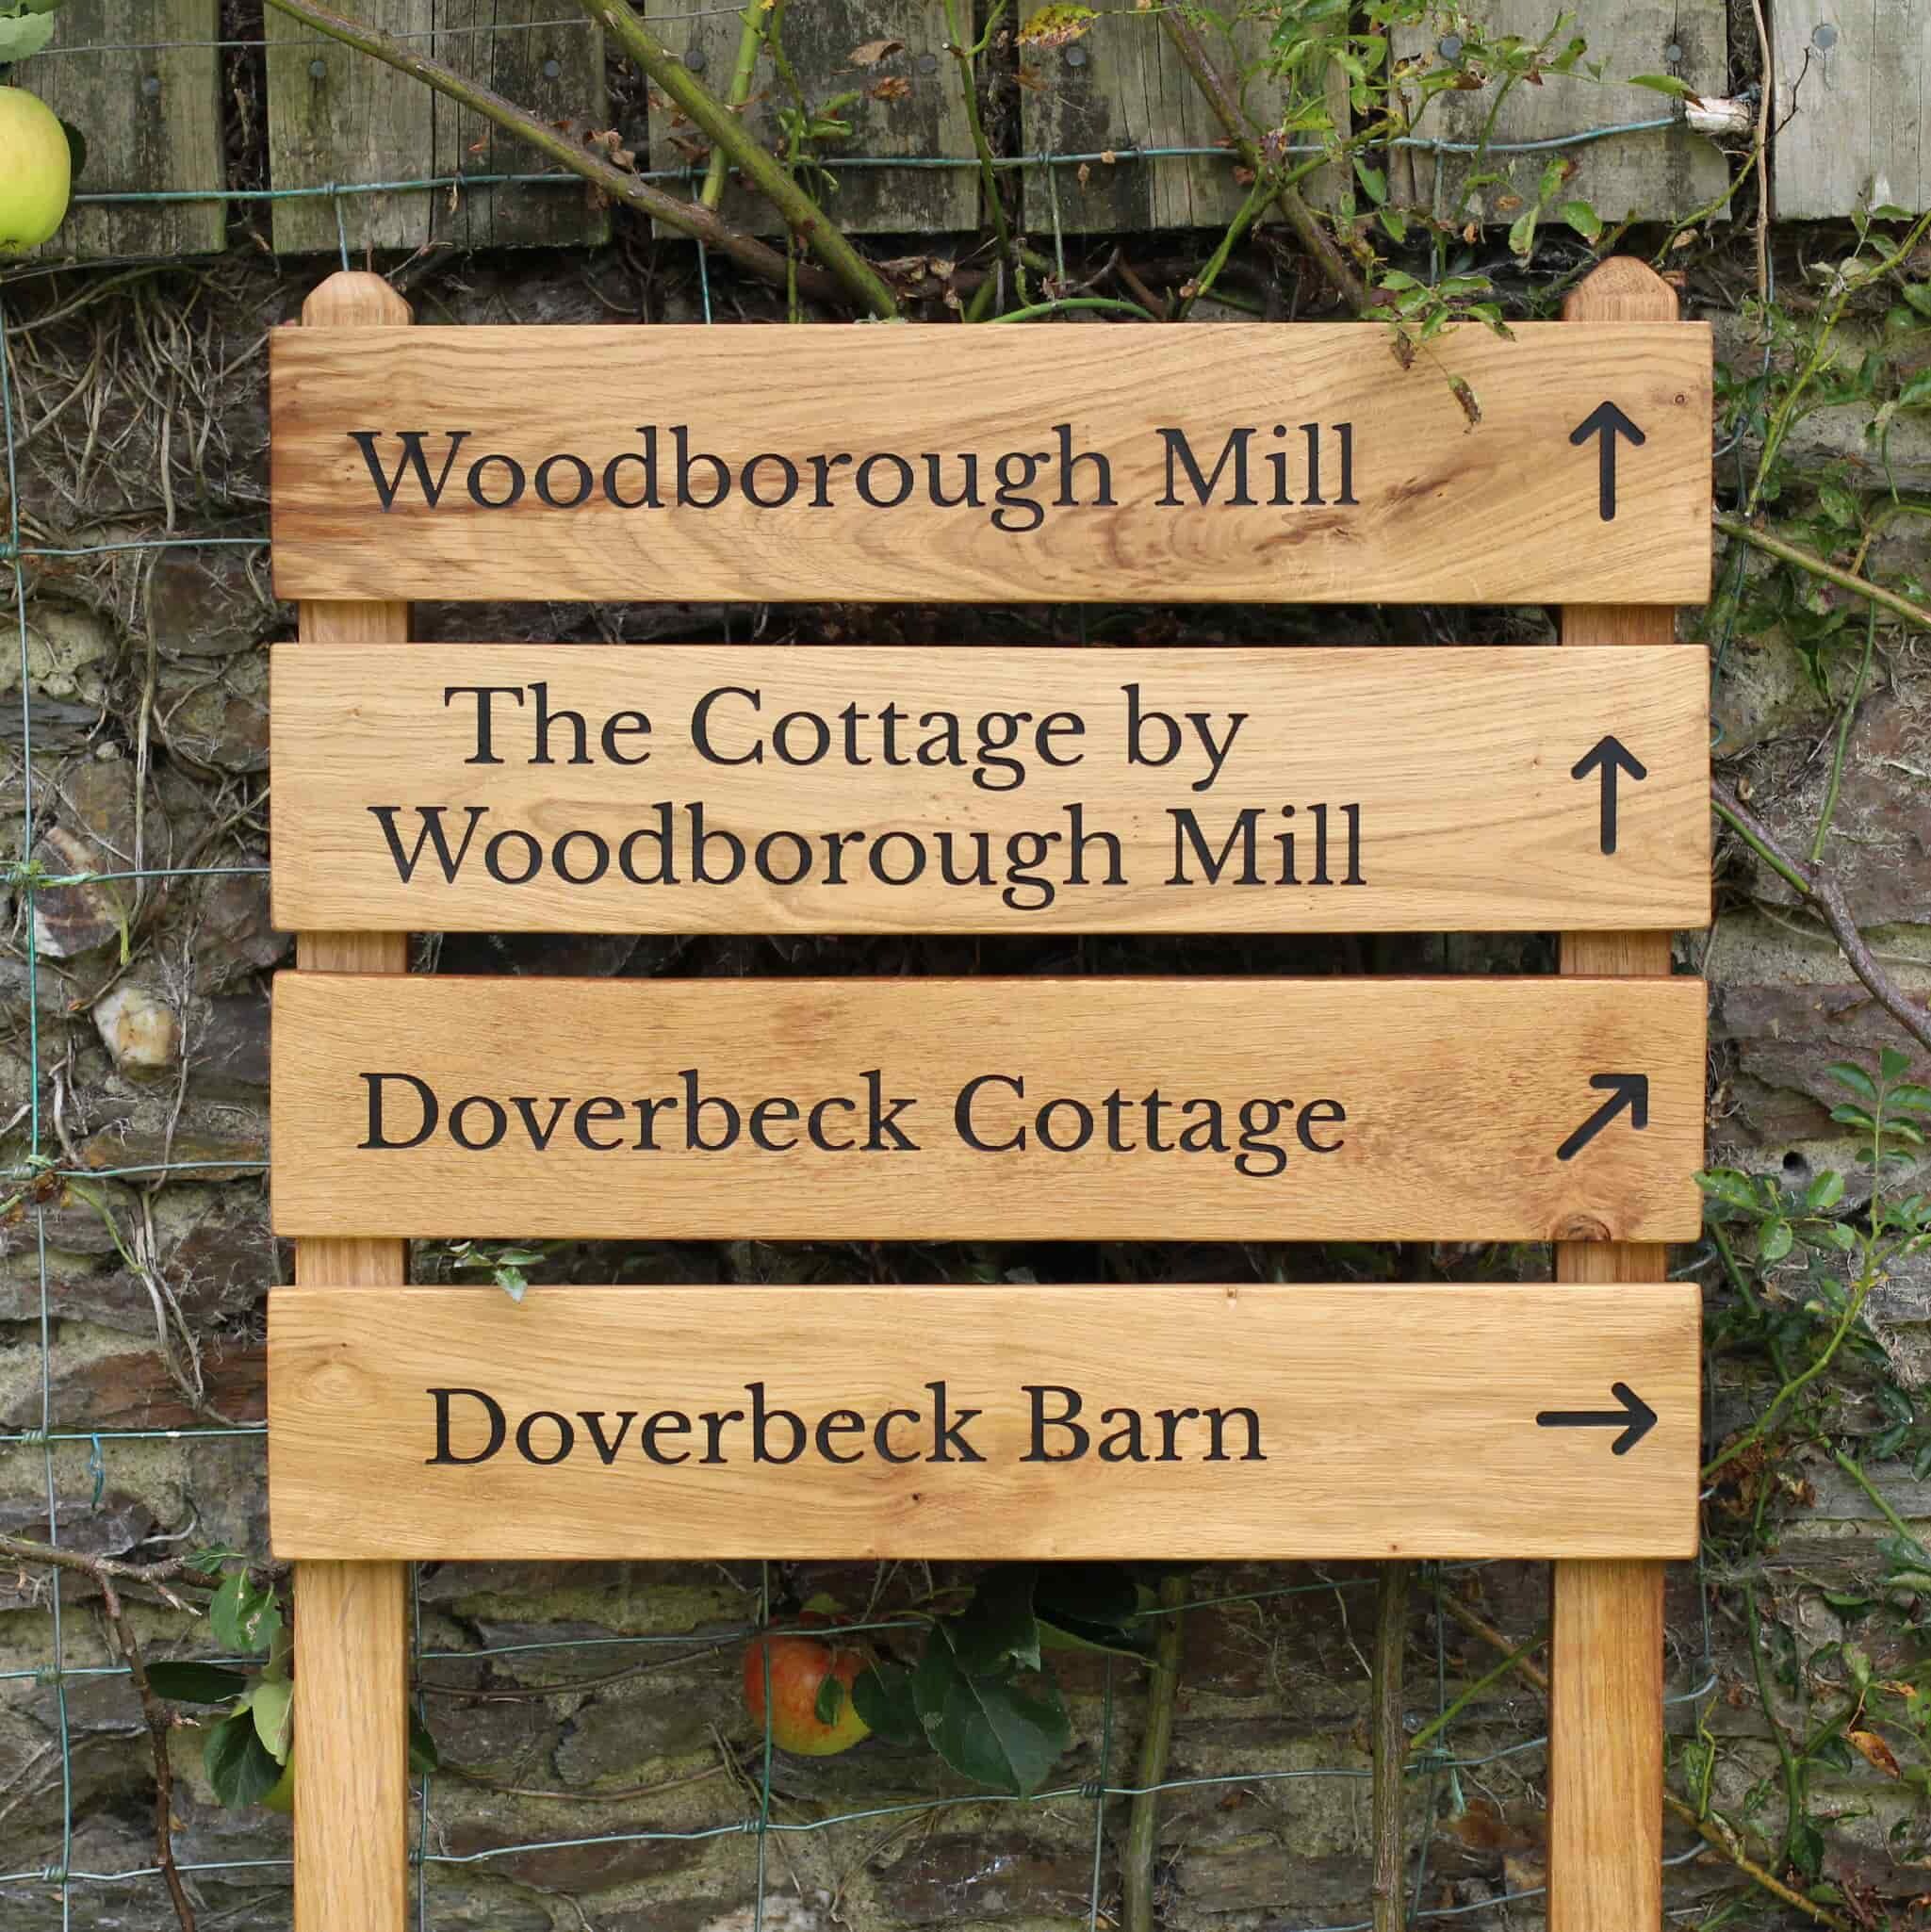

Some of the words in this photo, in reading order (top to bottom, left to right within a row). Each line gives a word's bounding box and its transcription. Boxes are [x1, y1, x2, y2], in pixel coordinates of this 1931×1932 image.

[346, 423, 1119, 532] Woodborough
[1154, 421, 1360, 507] Mill
[444, 681, 652, 765] The
[691, 686, 1086, 792] Cottage
[1121, 683, 1249, 793] by
[367, 801, 1128, 911] Woodborough
[1164, 803, 1367, 886] Mill
[356, 1068, 922, 1152] Doverbeck
[954, 1074, 1347, 1178] Cottage
[424, 1381, 988, 1465] Doverbeck
[1019, 1385, 1268, 1463] Barn
